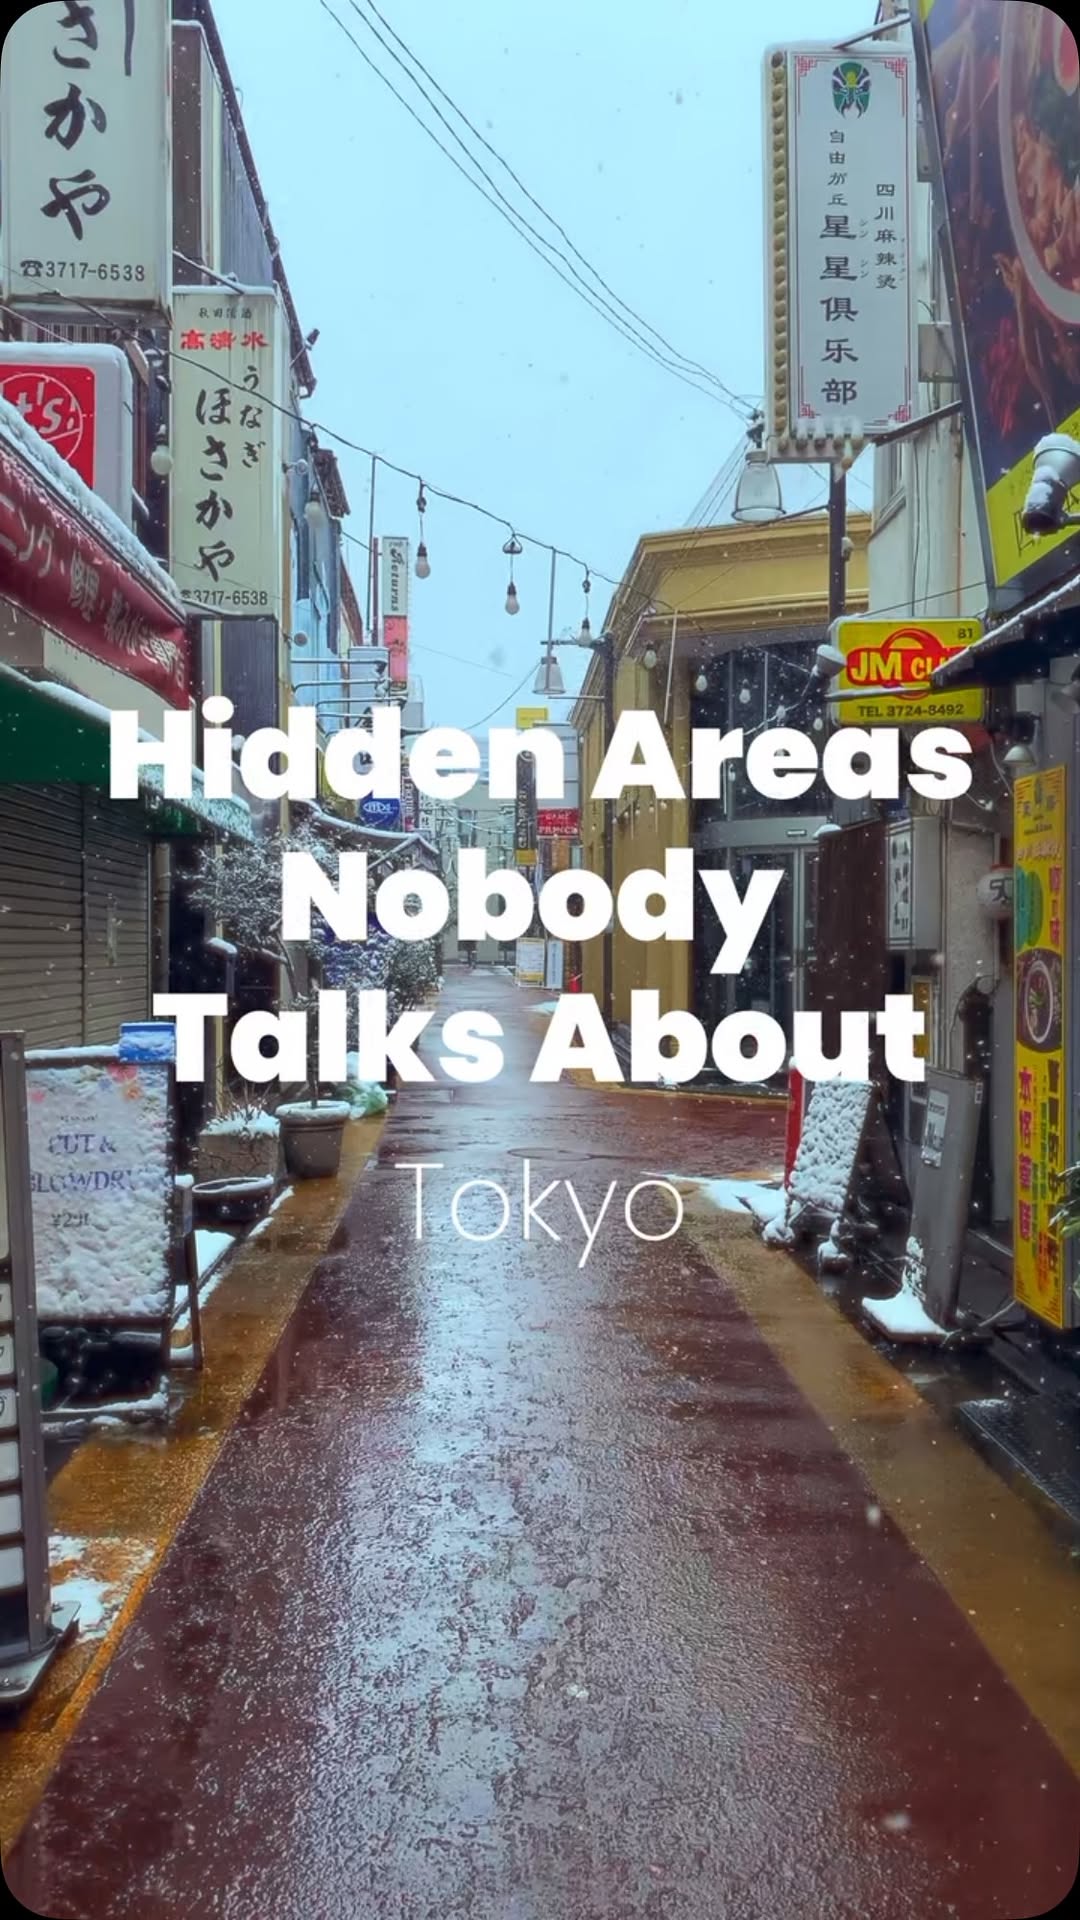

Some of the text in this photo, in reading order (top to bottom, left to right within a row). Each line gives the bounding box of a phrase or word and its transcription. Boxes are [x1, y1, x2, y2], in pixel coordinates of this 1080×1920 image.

[827, 130, 848, 206] 自由が丘
[46, 261, 146, 281] 3717-6538
[240, 365, 267, 468] うなぎ
[193, 388, 236, 583] ほさかや
[193, 590, 268, 606] 3717-6538
[850, 651, 902, 682] JM
[857, 703, 965, 717] TEL 3724-8492
